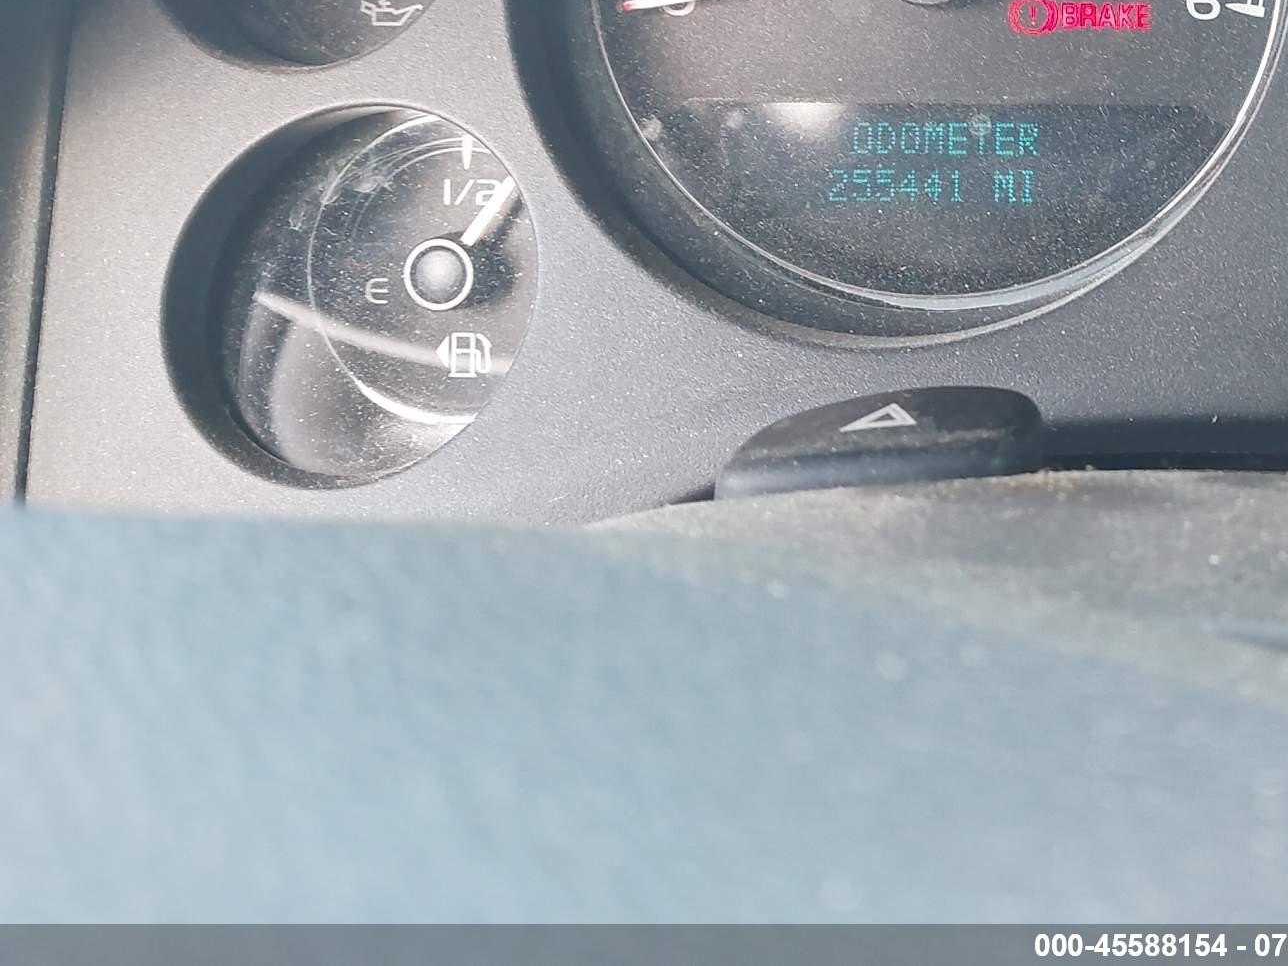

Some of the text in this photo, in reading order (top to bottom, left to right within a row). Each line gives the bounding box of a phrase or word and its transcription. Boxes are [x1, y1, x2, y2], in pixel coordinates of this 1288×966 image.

[1060, 1, 1153, 31] BRAKE
[853, 121, 1039, 156] ODOMETER
[828, 168, 1034, 203] 255441 MI
